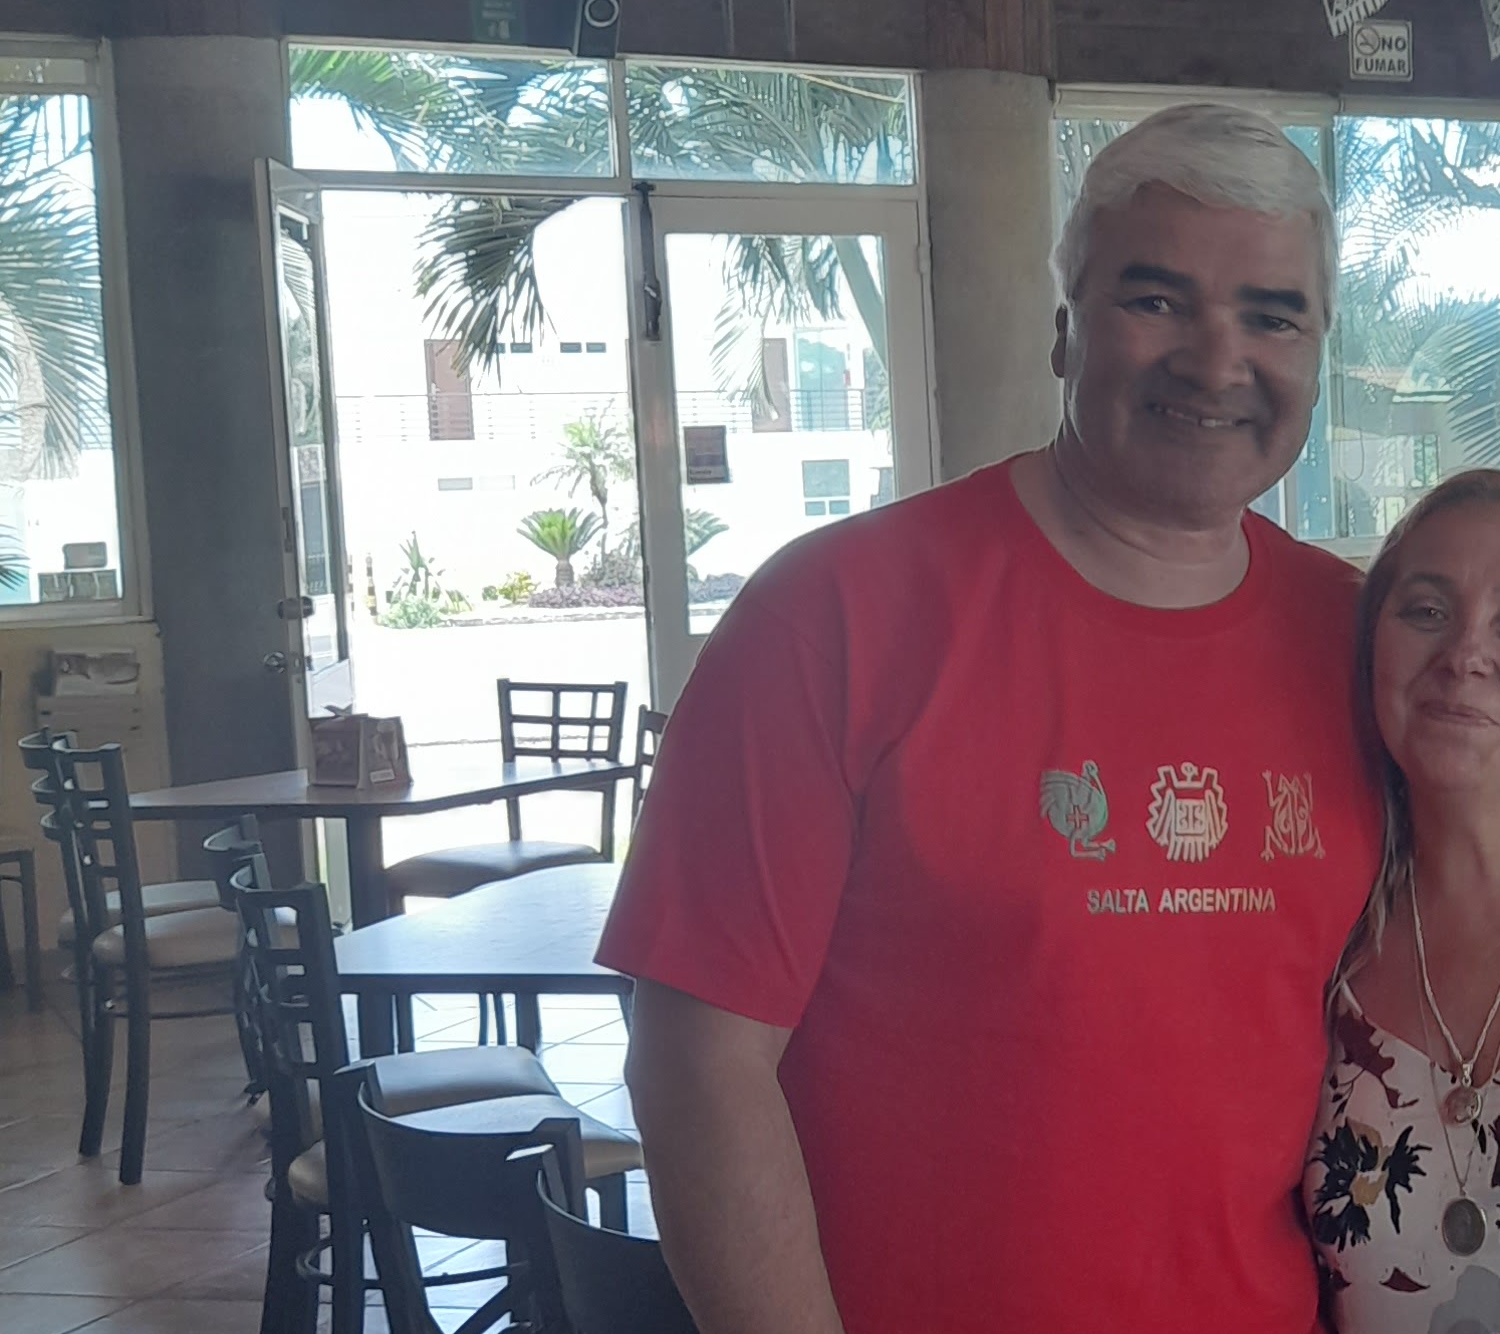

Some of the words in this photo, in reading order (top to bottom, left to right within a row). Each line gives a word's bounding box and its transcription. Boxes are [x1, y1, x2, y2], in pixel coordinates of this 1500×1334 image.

[1381, 36, 1406, 52] NO
[1356, 58, 1406, 73] FUMAR
[1087, 888, 1149, 914] SALTA
[1158, 887, 1276, 914] ARGENTINA
